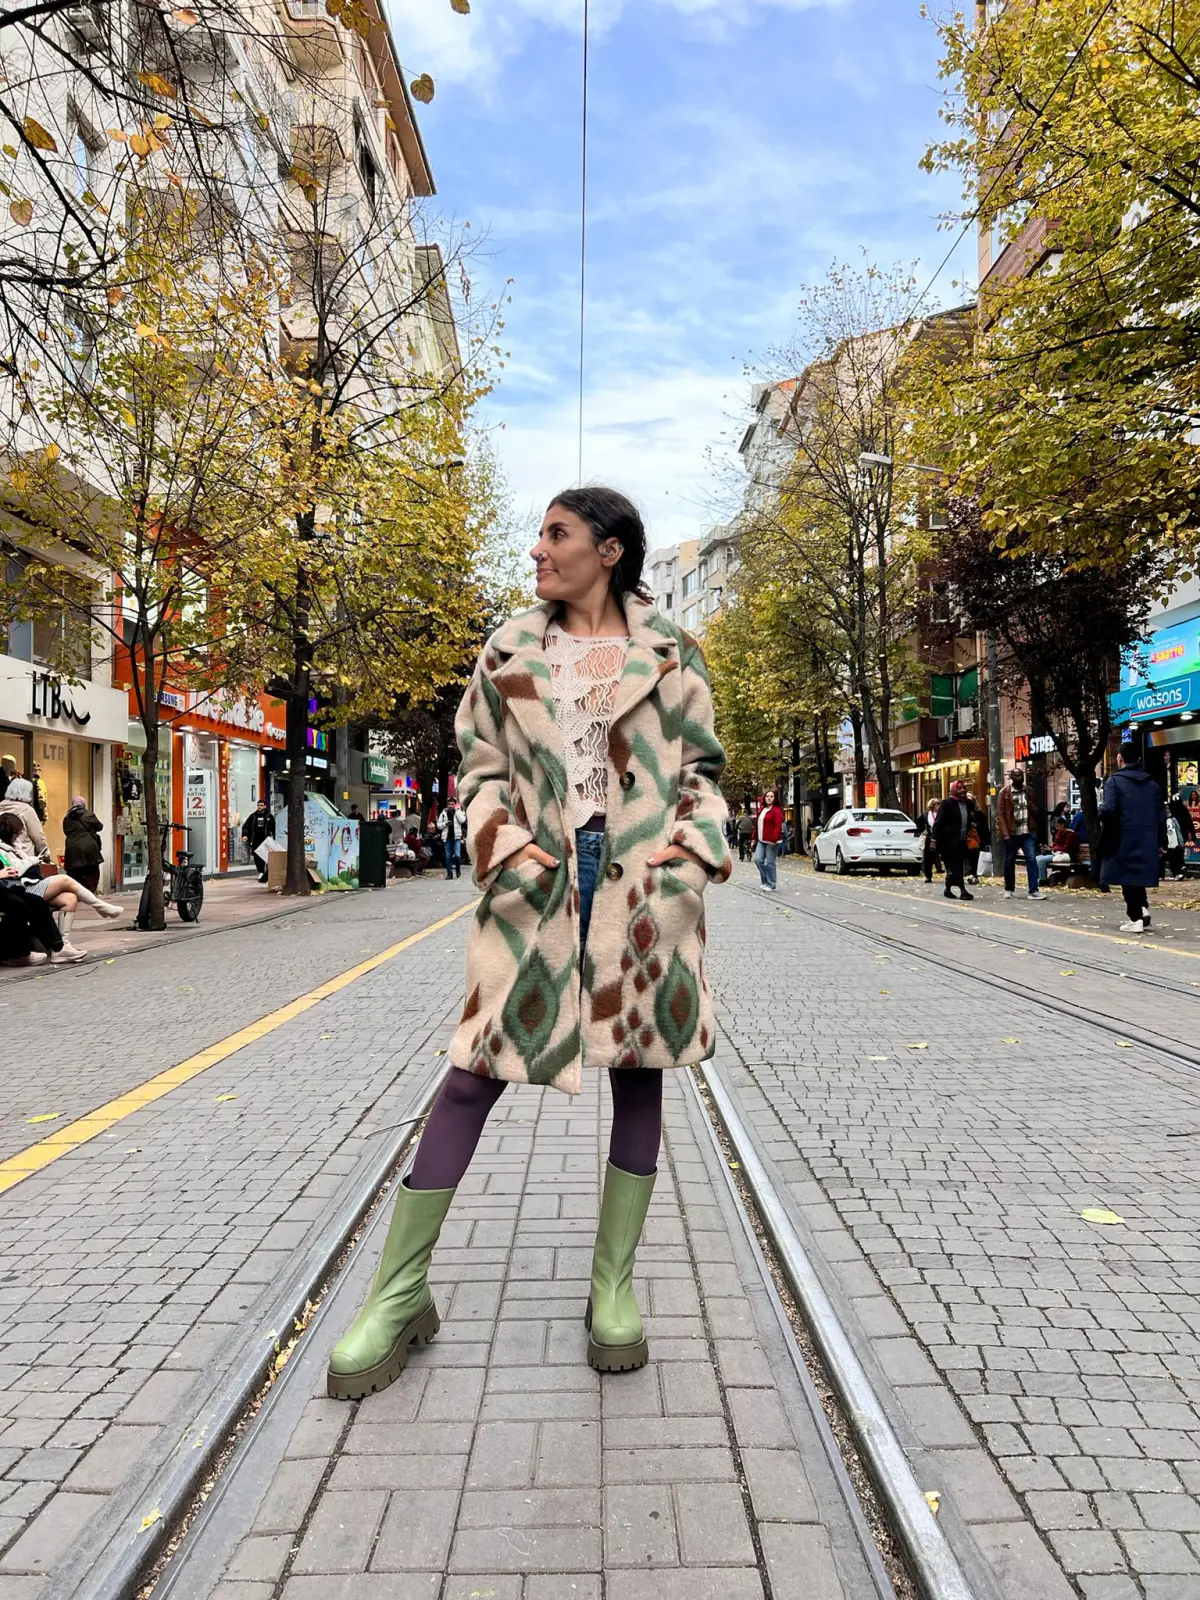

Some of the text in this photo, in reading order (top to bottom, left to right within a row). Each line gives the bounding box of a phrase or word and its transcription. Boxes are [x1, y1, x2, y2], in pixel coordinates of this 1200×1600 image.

[32, 670, 61, 719] LTB
[1136, 688, 1183, 710] watsons
[43, 743, 65, 760] LTB
[1015, 735, 1058, 761] IN STREE
